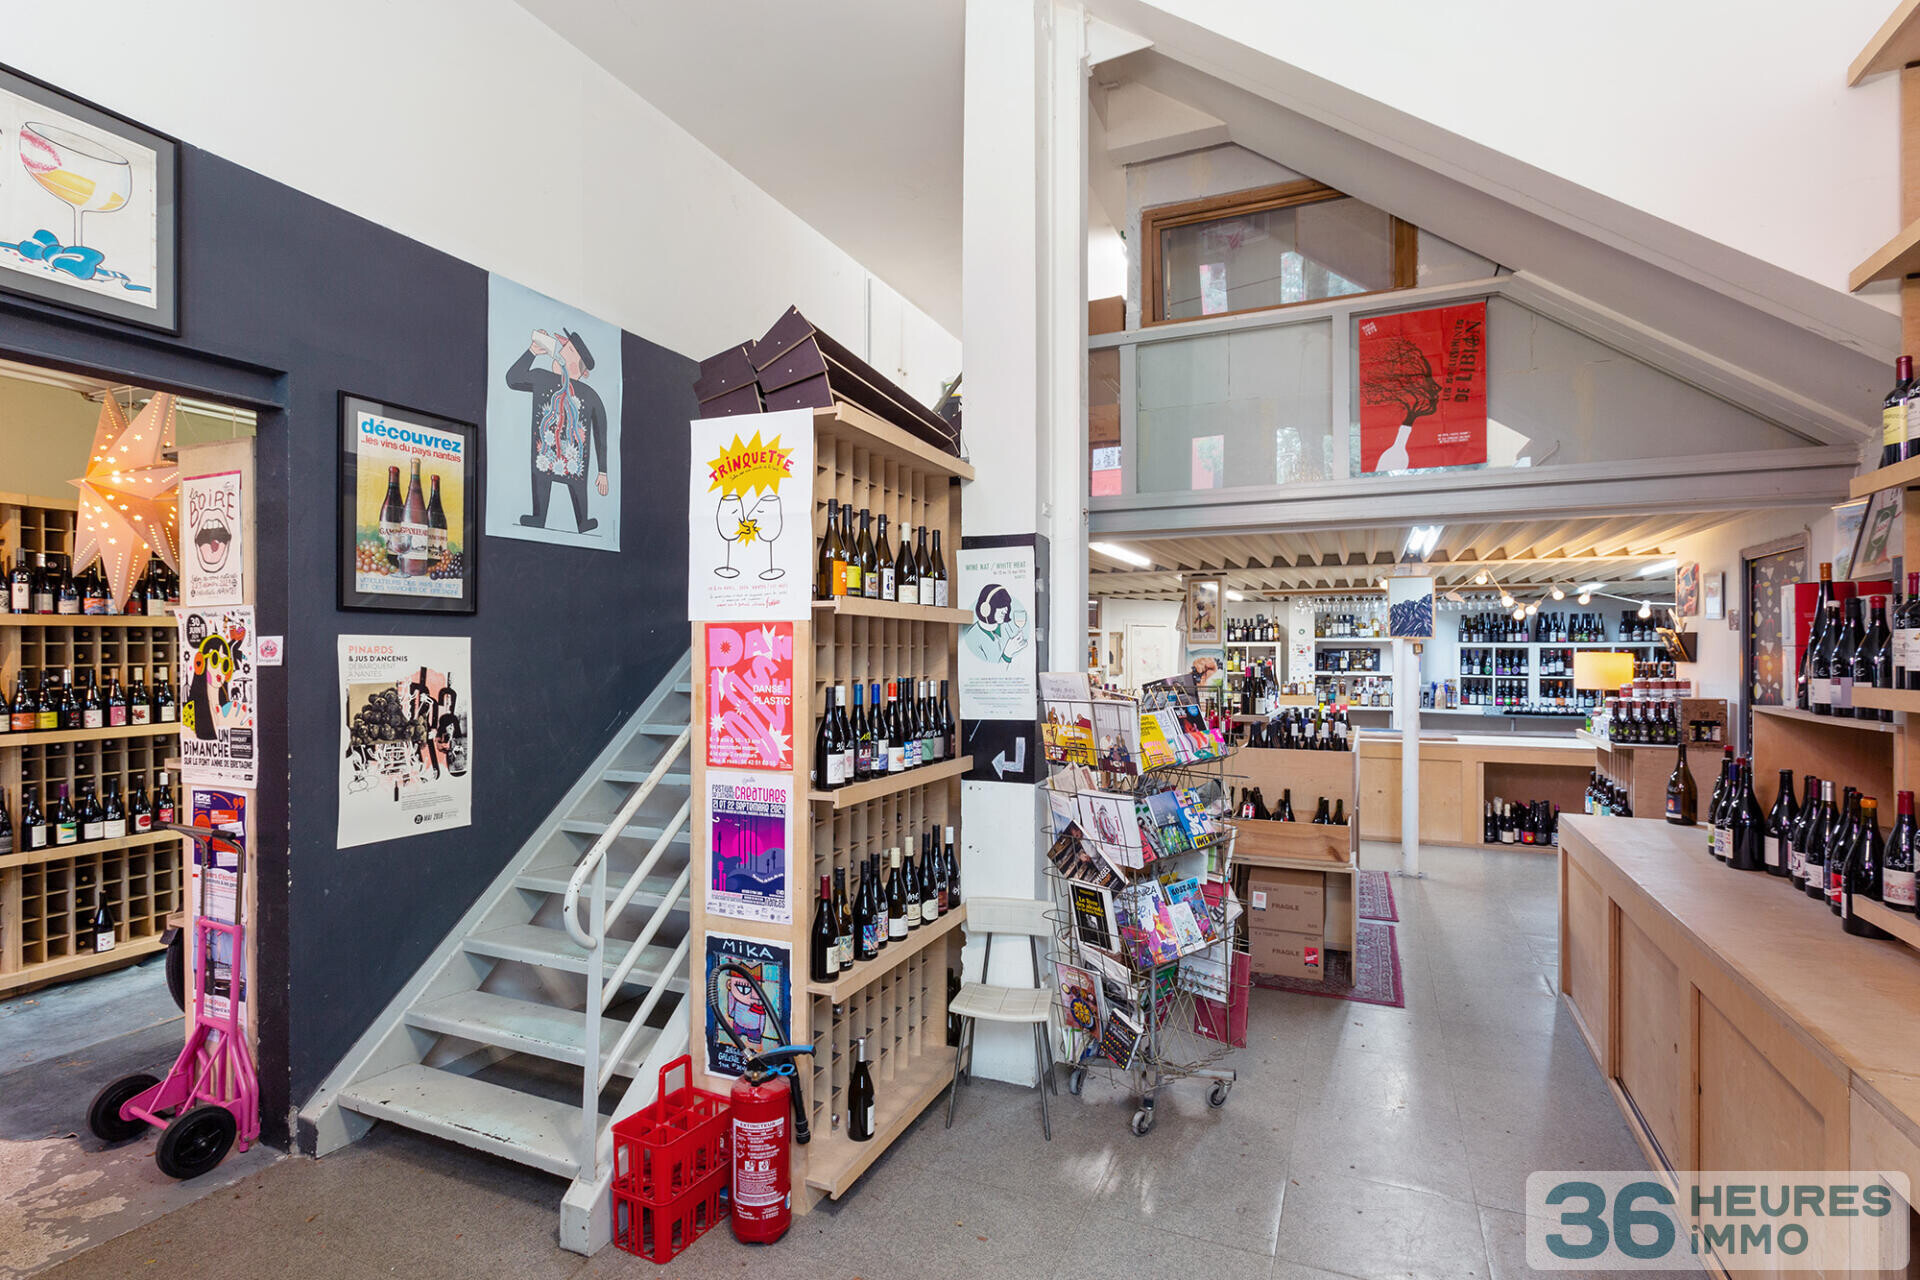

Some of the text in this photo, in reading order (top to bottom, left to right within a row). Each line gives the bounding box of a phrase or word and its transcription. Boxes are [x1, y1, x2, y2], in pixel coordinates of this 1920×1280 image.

[1454, 388, 1471, 402] DE
[361, 417, 461, 453] découvrez
[380, 439, 398, 450] vins
[399, 443, 410, 452] du
[411, 446, 432, 457] pays
[433, 450, 461, 463] nantais
[349, 645, 393, 655] PINARDS
[753, 684, 783, 694] DANSE
[753, 696, 791, 706] PLASTIC
[1271, 902, 1299, 911] FRAGILE
[1271, 948, 1299, 957] FRAGILE
